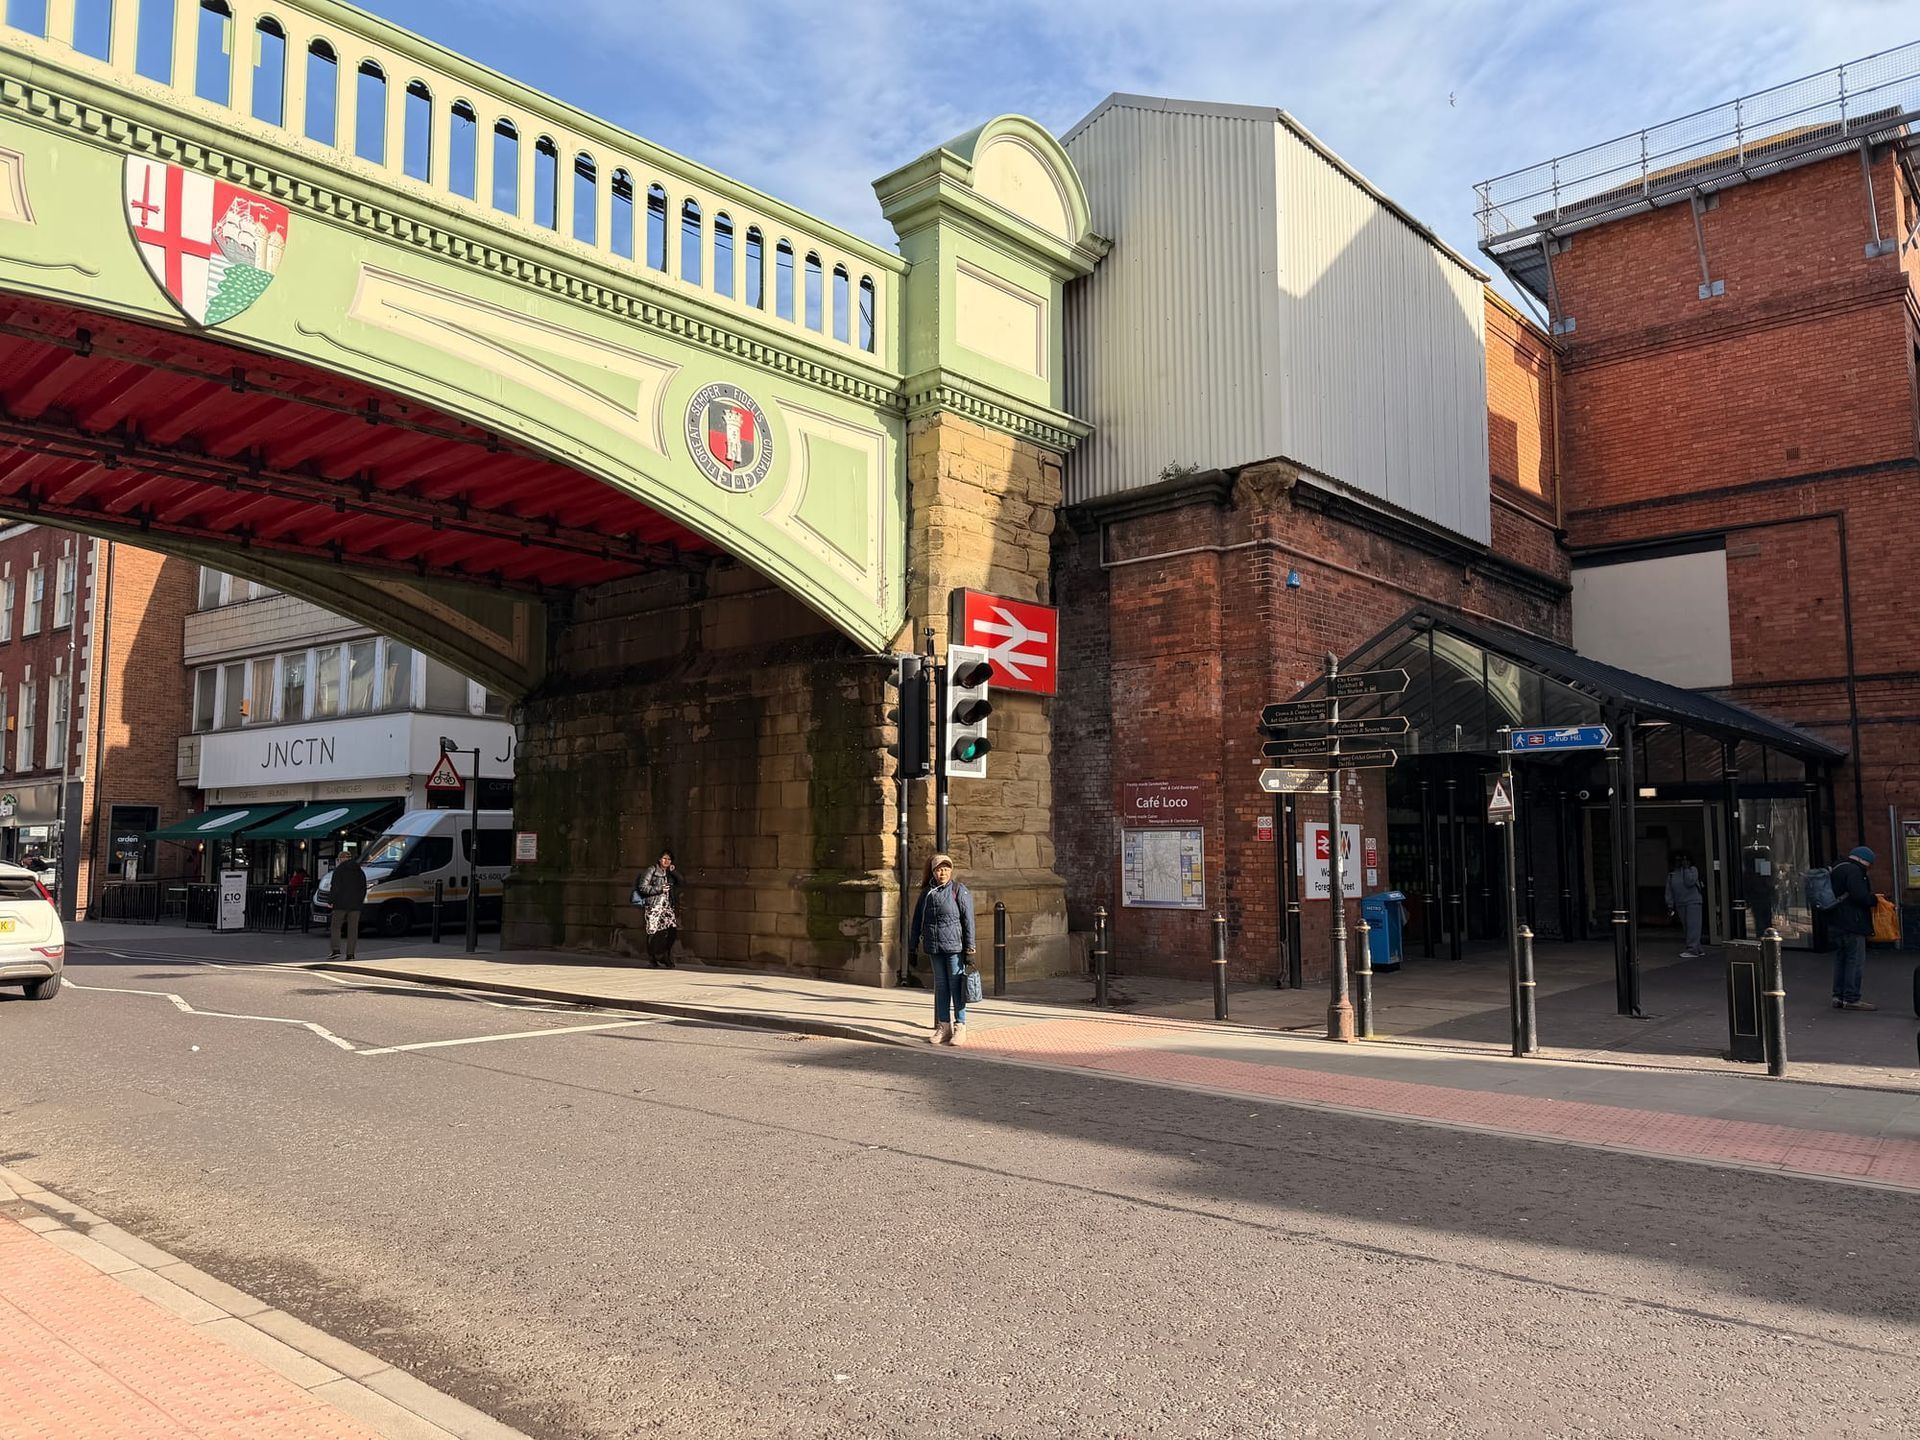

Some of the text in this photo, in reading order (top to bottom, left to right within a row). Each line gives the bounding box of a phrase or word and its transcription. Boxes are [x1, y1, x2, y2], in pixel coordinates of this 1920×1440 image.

[691, 385, 721, 417] SEMPER
[734, 388, 764, 423] FIDELIS
[688, 423, 717, 474] FLOREAT
[1548, 734, 1568, 743] Shrub
[261, 736, 336, 768] JNCTN
[325, 782, 396, 793] SANDWICHES CAKES
[1136, 794, 1188, 808] Café Loco
[117, 835, 138, 843] arden
[224, 893, 241, 901] £10
